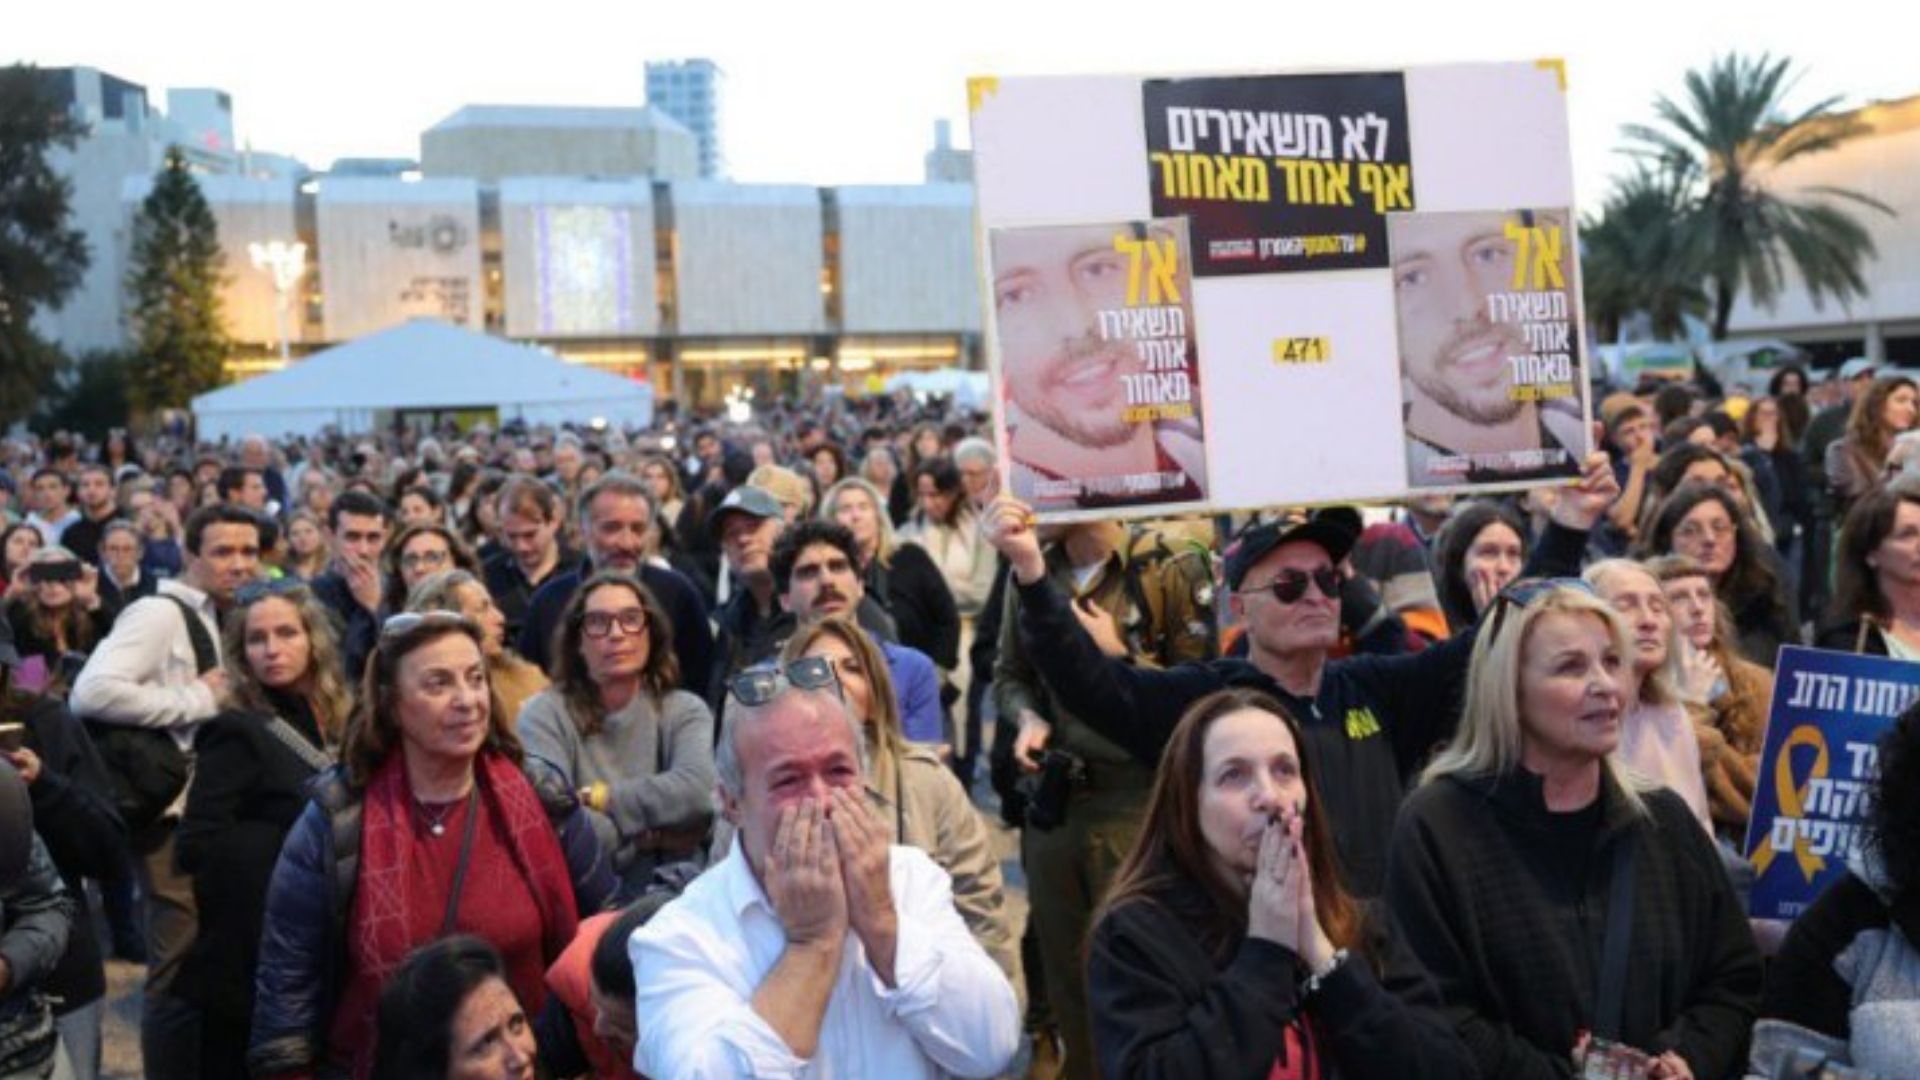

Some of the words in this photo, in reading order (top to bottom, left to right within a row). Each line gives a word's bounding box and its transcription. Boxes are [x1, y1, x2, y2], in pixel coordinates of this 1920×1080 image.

[1167, 106, 1333, 159] משאירים
[1340, 113, 1389, 161] לא
[1151, 152, 1270, 201] מאחור
[1276, 158, 1353, 206] אחד
[1358, 163, 1411, 213] אף
[1113, 234, 1181, 307] אל
[1504, 220, 1565, 290] אל
[1098, 306, 1185, 340] תשאירו
[1486, 291, 1568, 323] תשאירו
[1136, 339, 1188, 371] אותי
[1283, 337, 1322, 364] 471
[1522, 321, 1570, 353] אותי
[1120, 370, 1191, 403] מאחור
[1508, 353, 1572, 384] מאחור
[1787, 671, 1848, 710] הרוב
